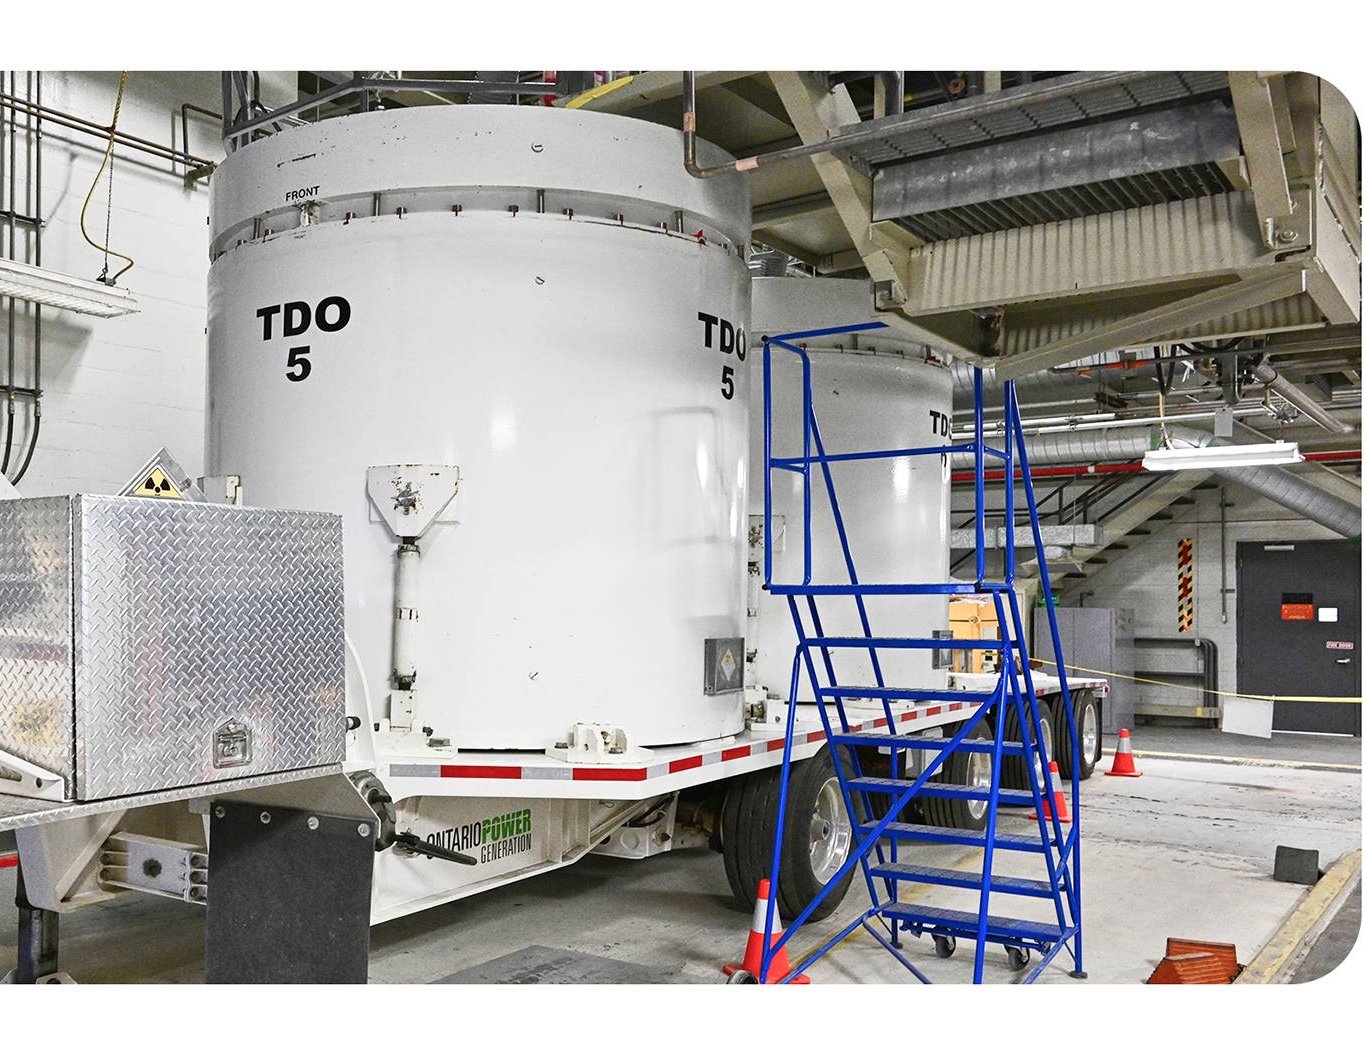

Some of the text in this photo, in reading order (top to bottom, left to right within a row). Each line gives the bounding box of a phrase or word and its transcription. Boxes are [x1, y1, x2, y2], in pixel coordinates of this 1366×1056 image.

[285, 185, 320, 202] FRONT
[256, 296, 351, 341] TDO
[697, 311, 746, 362] TDO
[285, 345, 312, 382] 5
[721, 365, 734, 401] 5
[480, 833, 532, 864] GENERATION
